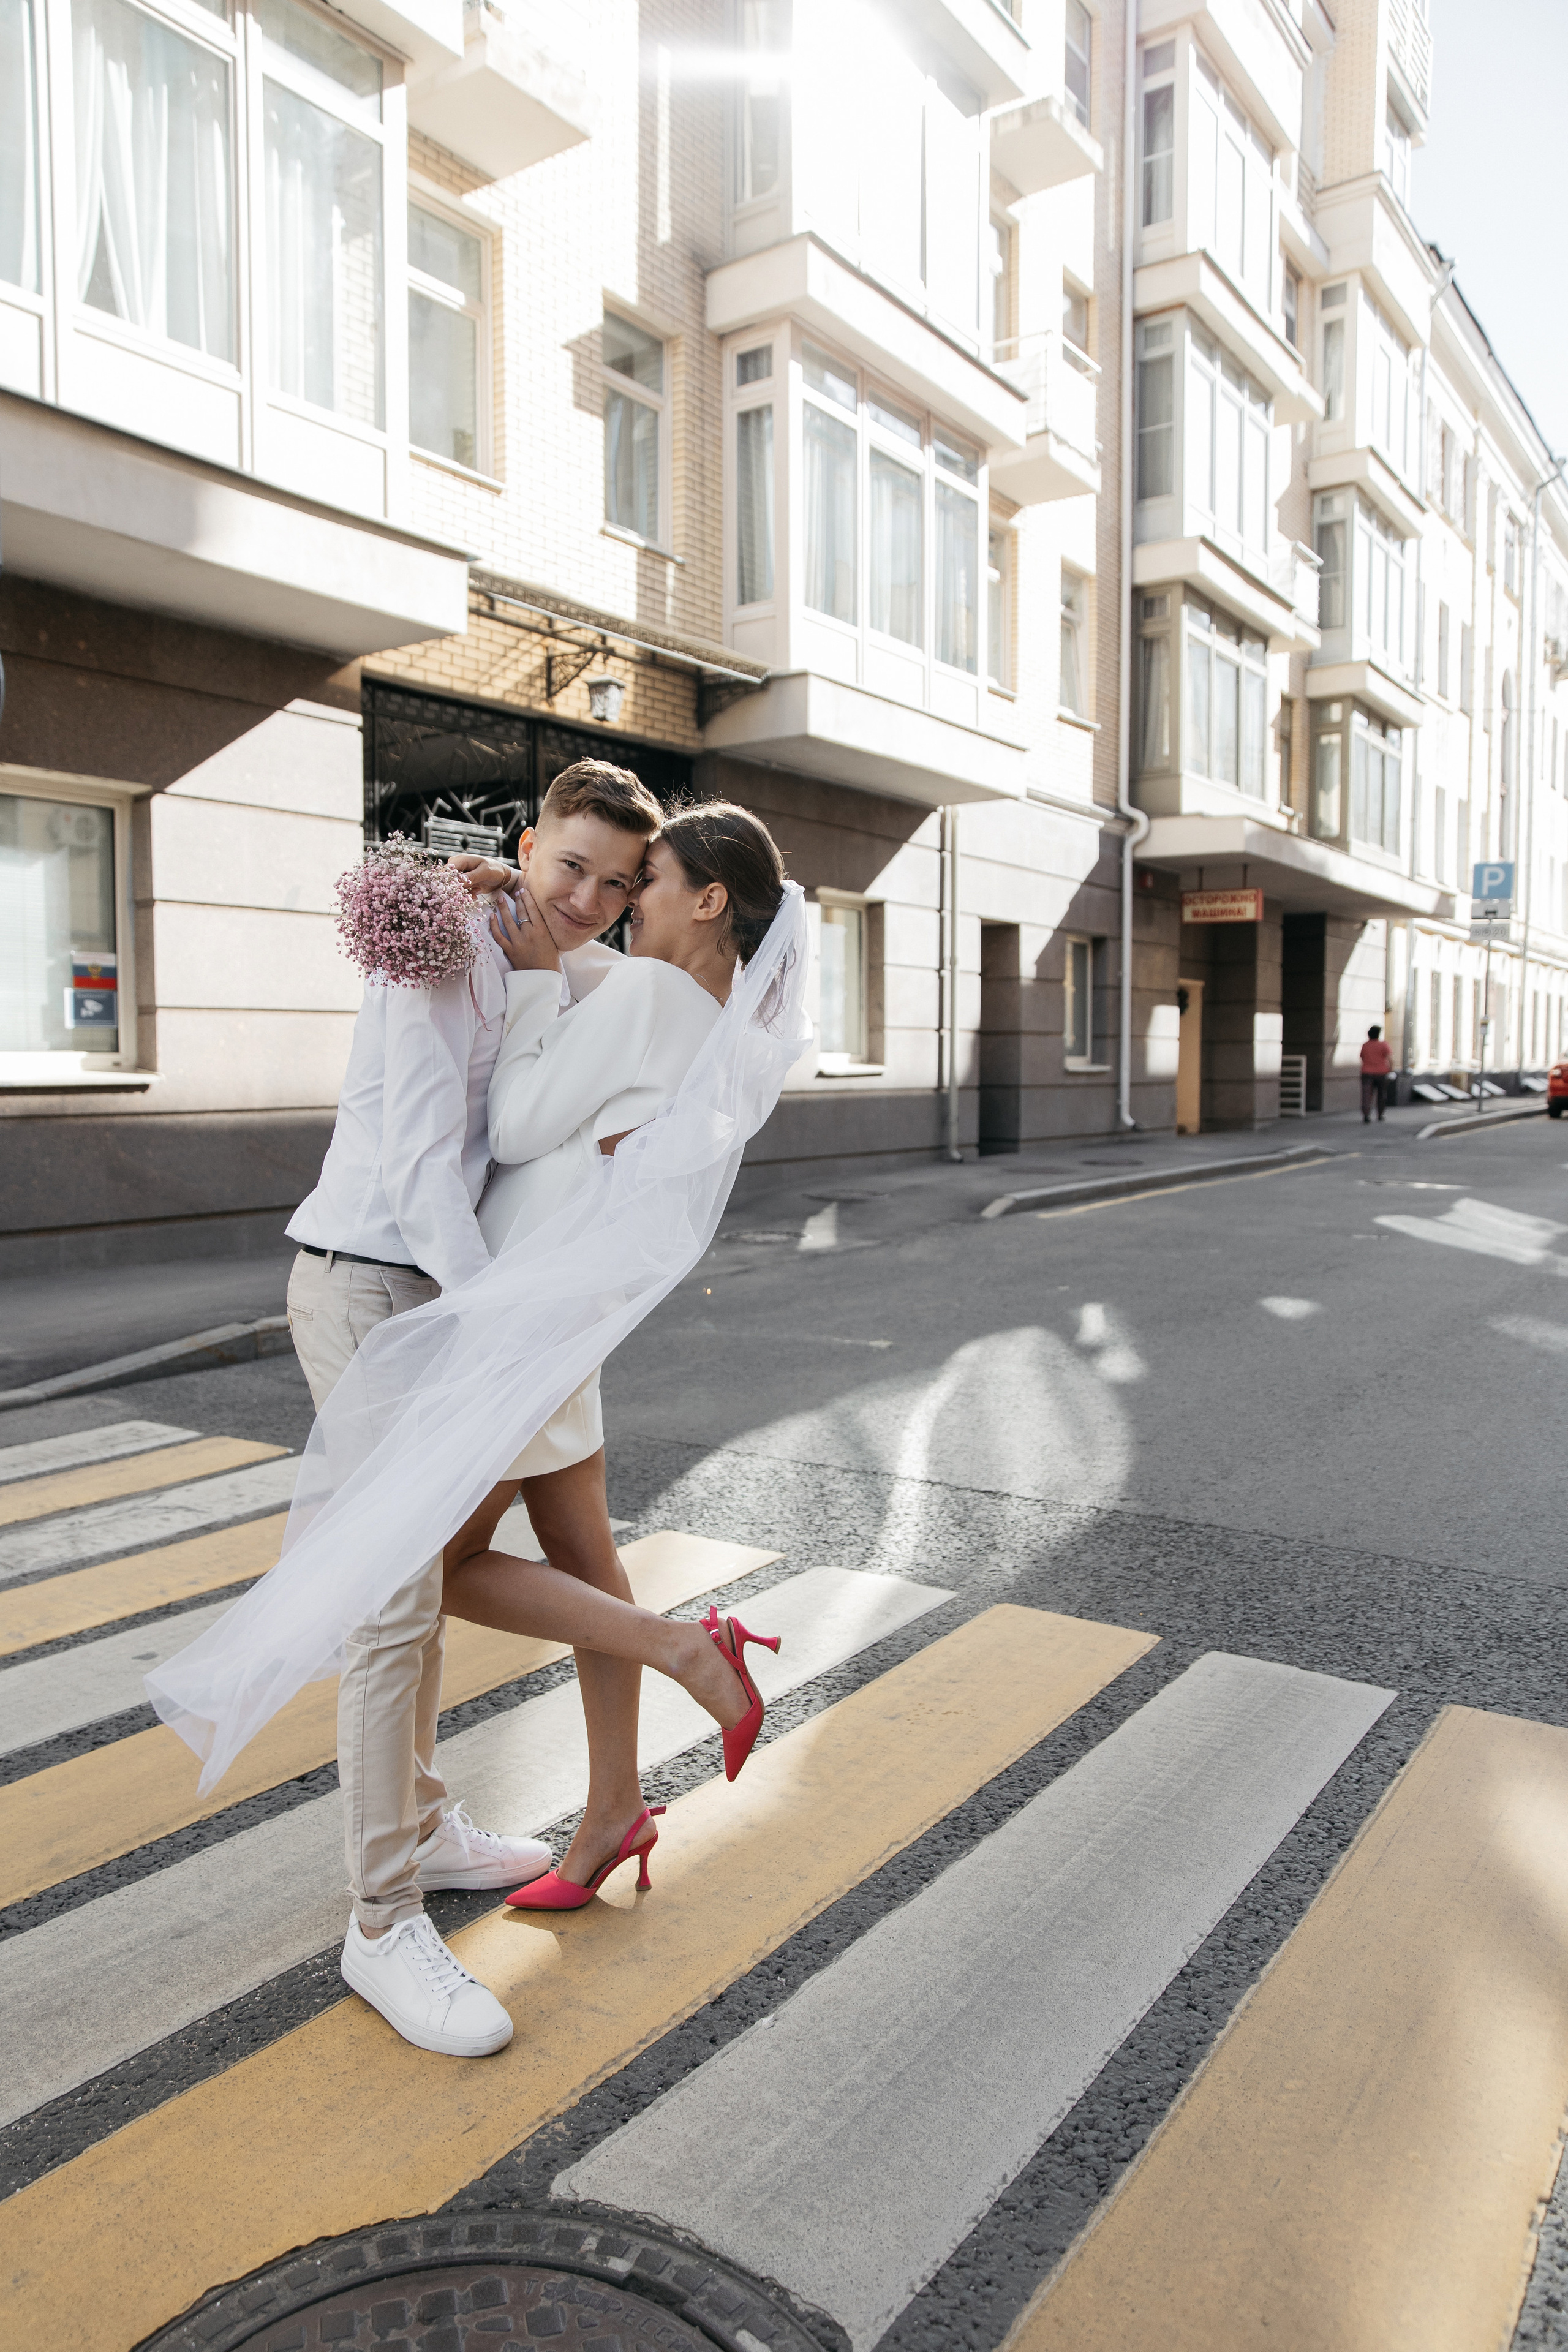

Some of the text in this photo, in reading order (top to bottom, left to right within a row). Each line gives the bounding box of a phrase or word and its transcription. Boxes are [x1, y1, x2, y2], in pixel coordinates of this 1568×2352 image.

[1482, 867, 1506, 897] P
[1183, 894, 1256, 906] ОСТОРОЖНО
[1192, 908, 1246, 919] МАШИНА!
